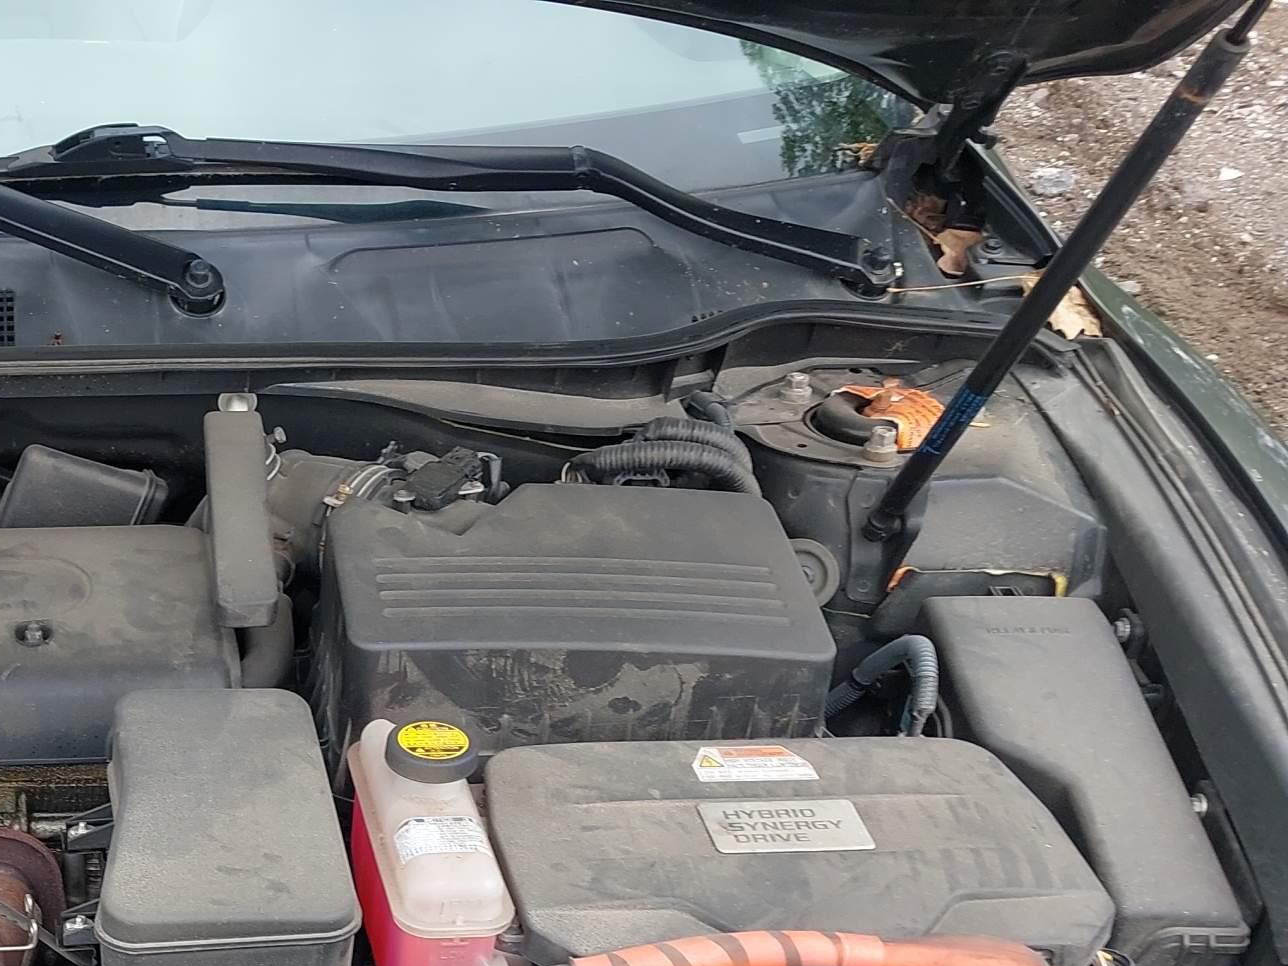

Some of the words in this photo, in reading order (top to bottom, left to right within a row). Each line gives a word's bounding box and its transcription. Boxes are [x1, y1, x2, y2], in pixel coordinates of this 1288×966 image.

[722, 808, 816, 820] HYBRID
[725, 820, 843, 832] SYNERGY
[733, 832, 811, 844] DRIVE
